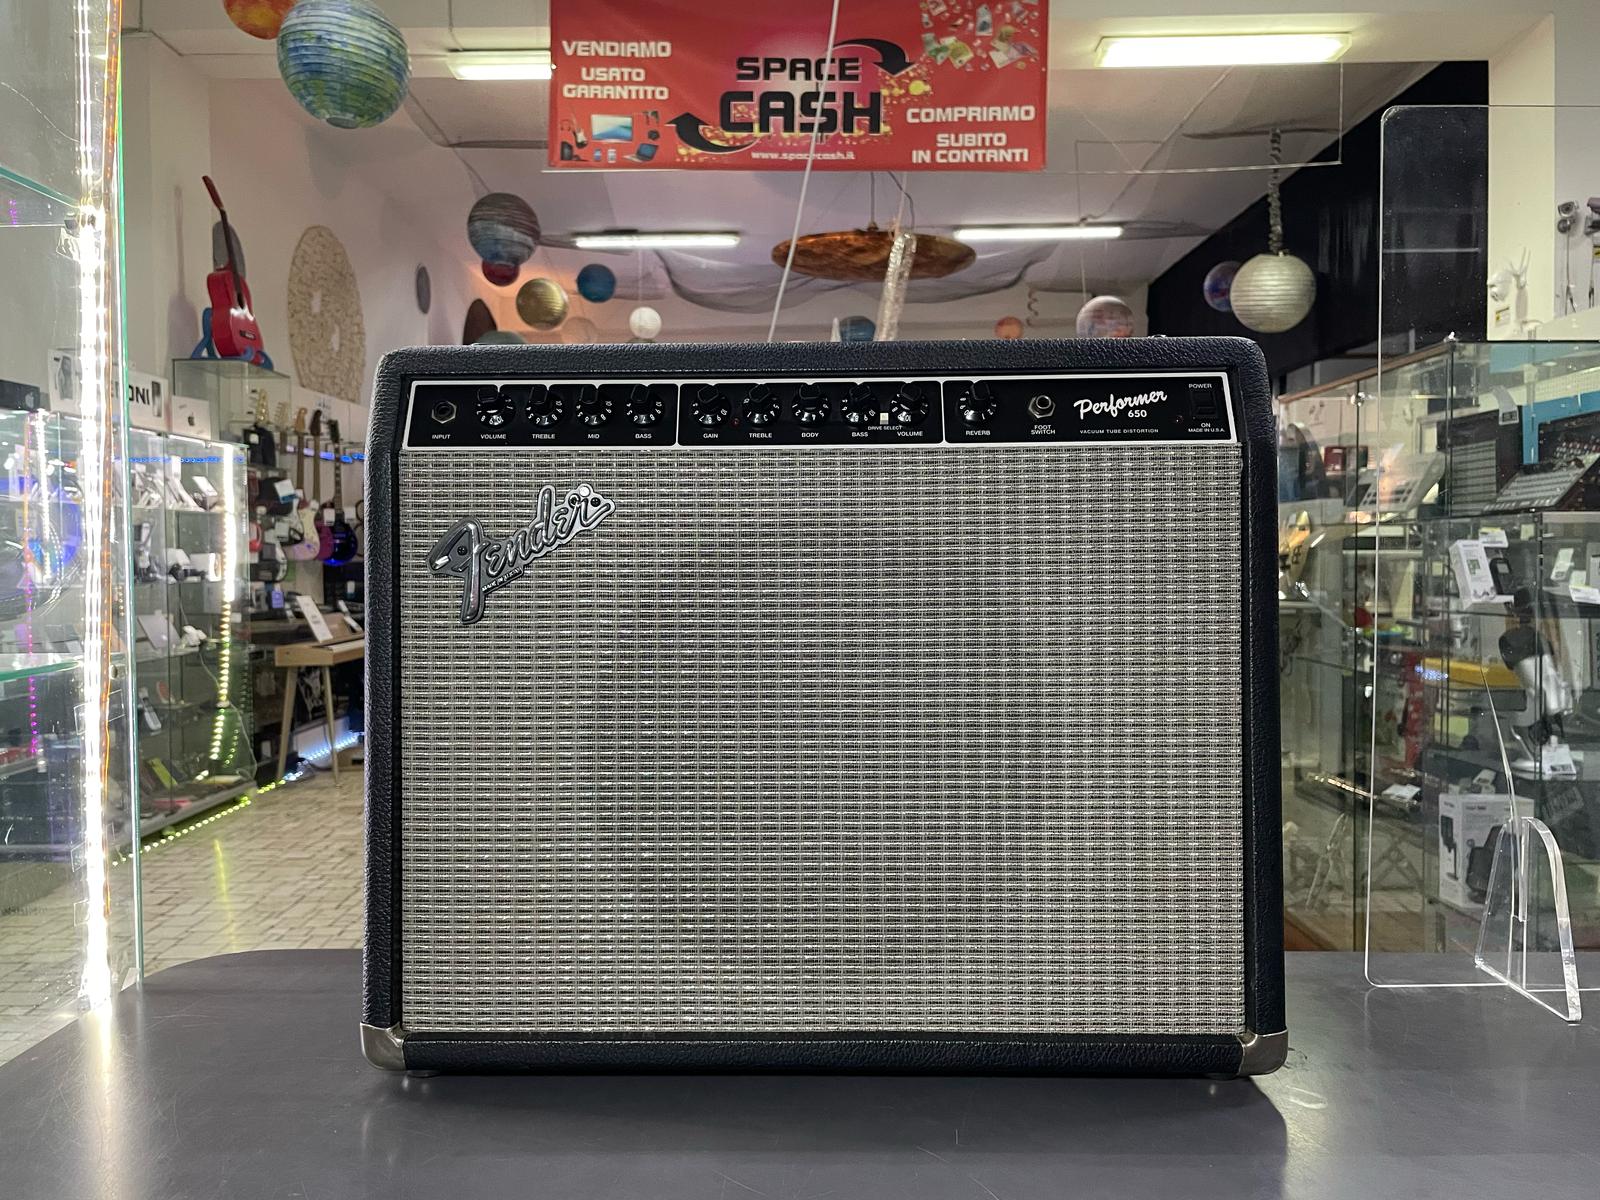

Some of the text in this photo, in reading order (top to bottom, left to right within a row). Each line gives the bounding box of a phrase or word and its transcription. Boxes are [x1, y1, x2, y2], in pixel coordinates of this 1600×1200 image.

[562, 41, 672, 58] VENDIAMO
[581, 67, 646, 82] USATO
[736, 57, 861, 82] SPACE
[562, 85, 670, 100] GARANTITO
[719, 91, 885, 134] CASH
[906, 106, 1036, 124] COMPRIAMO
[936, 132, 1008, 148] SUBITO
[912, 148, 1029, 164] IN CONTANTI
[1073, 390, 1168, 420] Performer
[1128, 410, 1147, 418] 650
[427, 484, 614, 623] Fender
